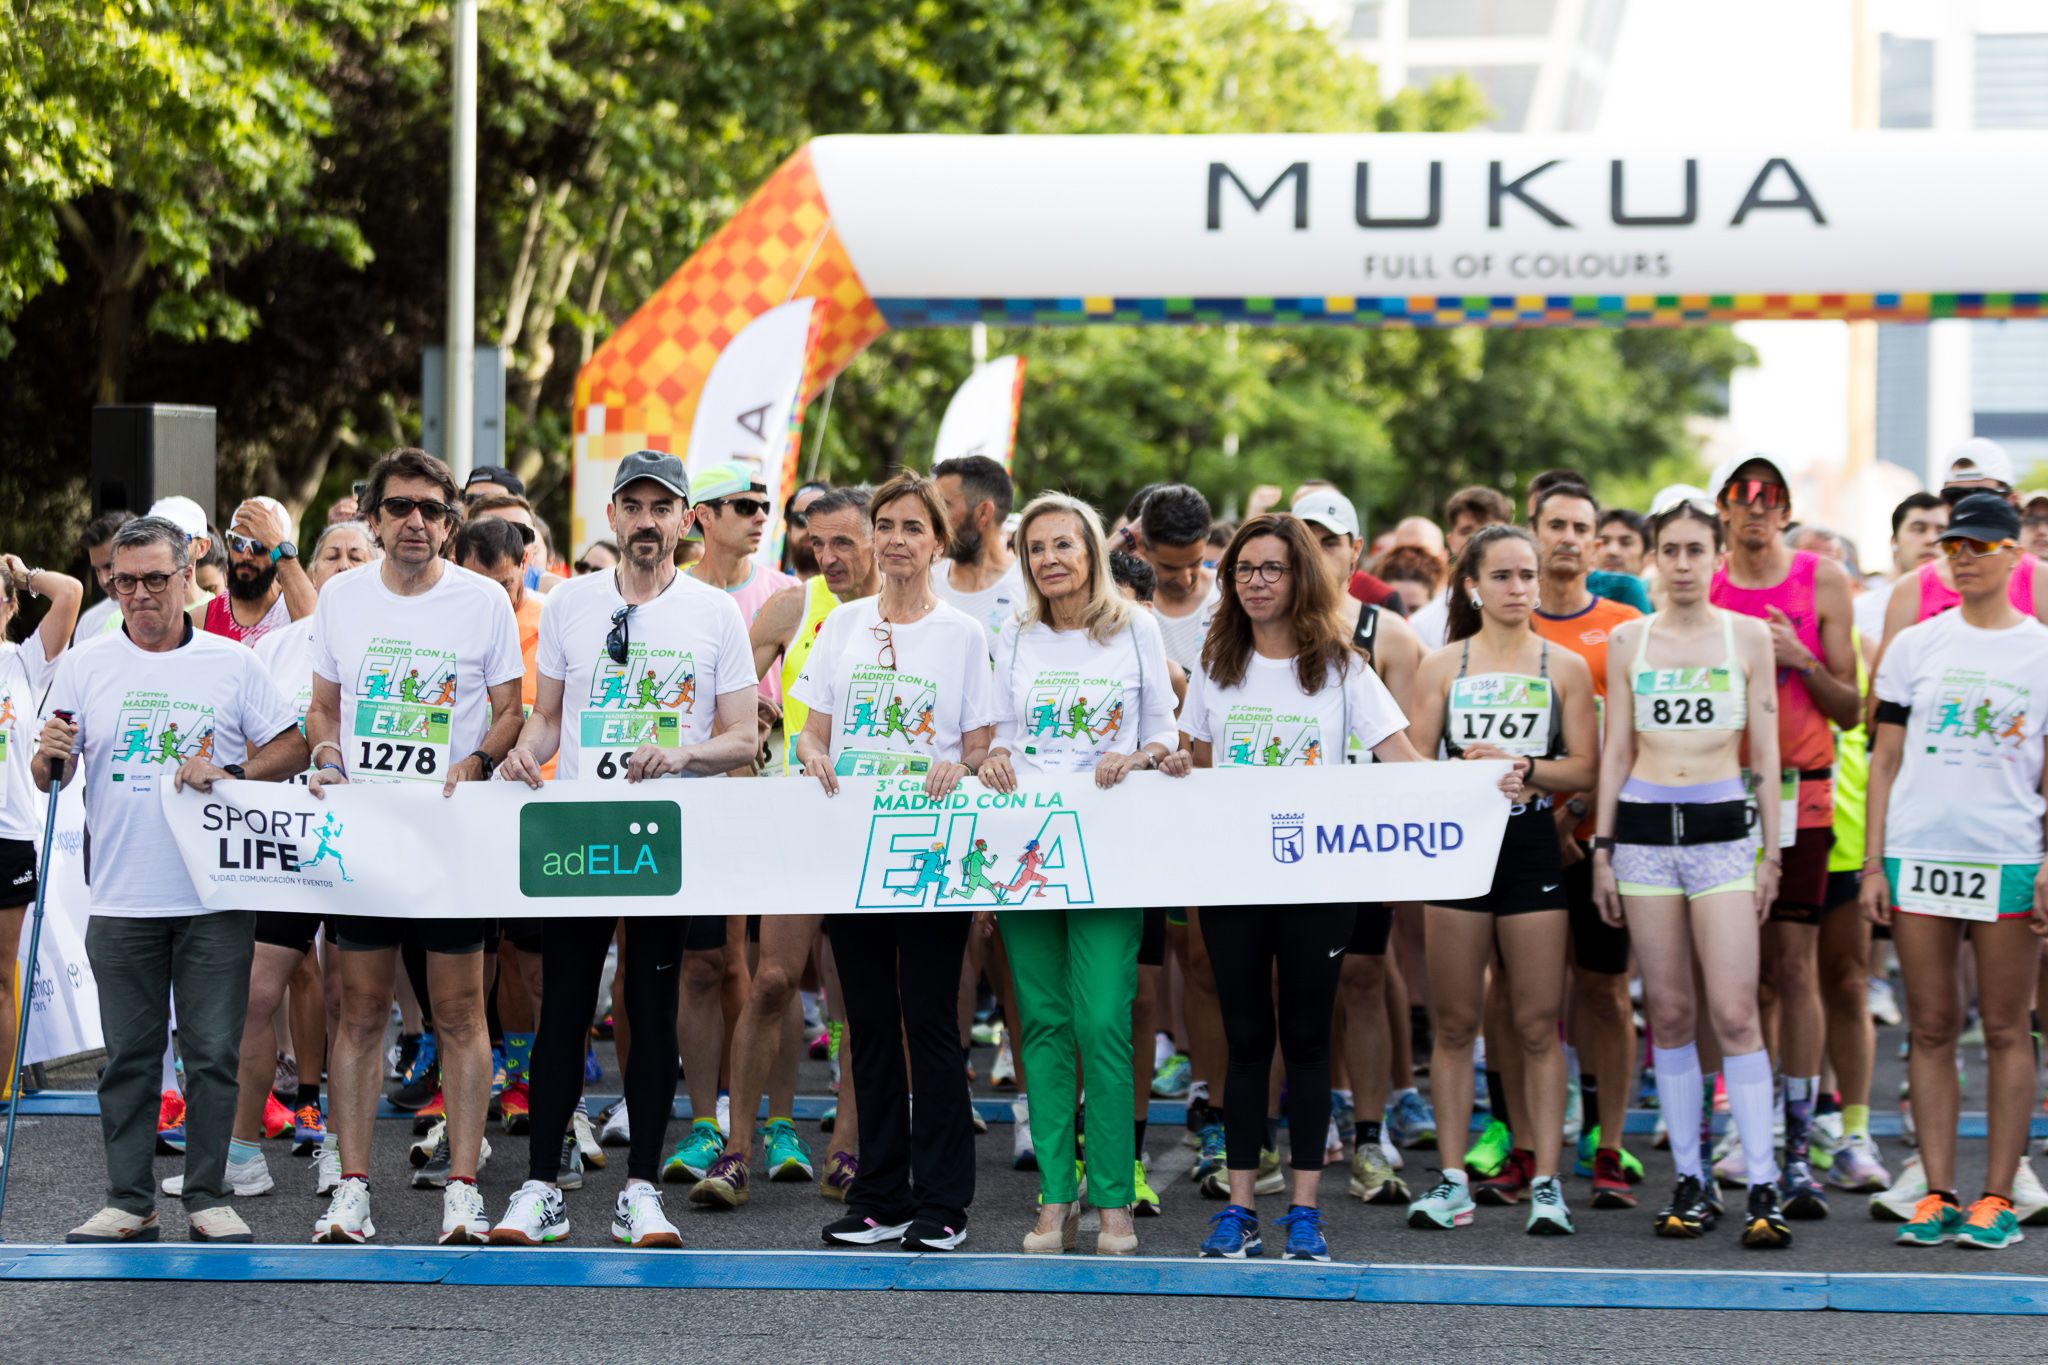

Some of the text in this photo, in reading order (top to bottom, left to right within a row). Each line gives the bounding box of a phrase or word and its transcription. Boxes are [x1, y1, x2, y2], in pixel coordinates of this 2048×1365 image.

[1206, 158, 1828, 231] MUKUA
[1364, 252, 1672, 281] FULL OF COLOURS
[367, 645, 457, 660] MADRID CON LA
[381, 637, 411, 646] Carrera
[650, 649, 676, 657] CON
[678, 651, 693, 659] LA
[356, 654, 457, 702] ELA
[590, 656, 696, 701] ELA
[851, 671, 937, 689] MADRID CON LA
[1033, 677, 1122, 688] MADRID CON LA
[1471, 679, 1498, 691] 0384
[1653, 667, 1711, 691] ELA
[122, 699, 215, 715] MADRID CON LA
[136, 690, 168, 699] Carrera
[844, 681, 937, 734] ELA
[1025, 686, 1125, 729] ELA
[1226, 713, 1319, 725] MADRID CON LA
[1241, 705, 1272, 714] Carrera
[1653, 697, 1715, 725] 828
[113, 708, 216, 758] ELA
[371, 710, 429, 739] ELA
[600, 719, 658, 744] ELA
[1463, 713, 1540, 740] 1767
[359, 741, 437, 775] 1278
[1223, 722, 1323, 766] ELA
[873, 791, 1064, 812] MADRID CON LA
[203, 803, 316, 838] SPORT
[1316, 822, 1464, 858] MADRID
[219, 837, 301, 873] LIFE
[542, 844, 659, 876] adELA
[856, 811, 1095, 909] ELA
[240, 874, 296, 885] COMUNICACIÓN
[302, 878, 334, 888] EVENTOS
[1910, 865, 1986, 900] 1012
